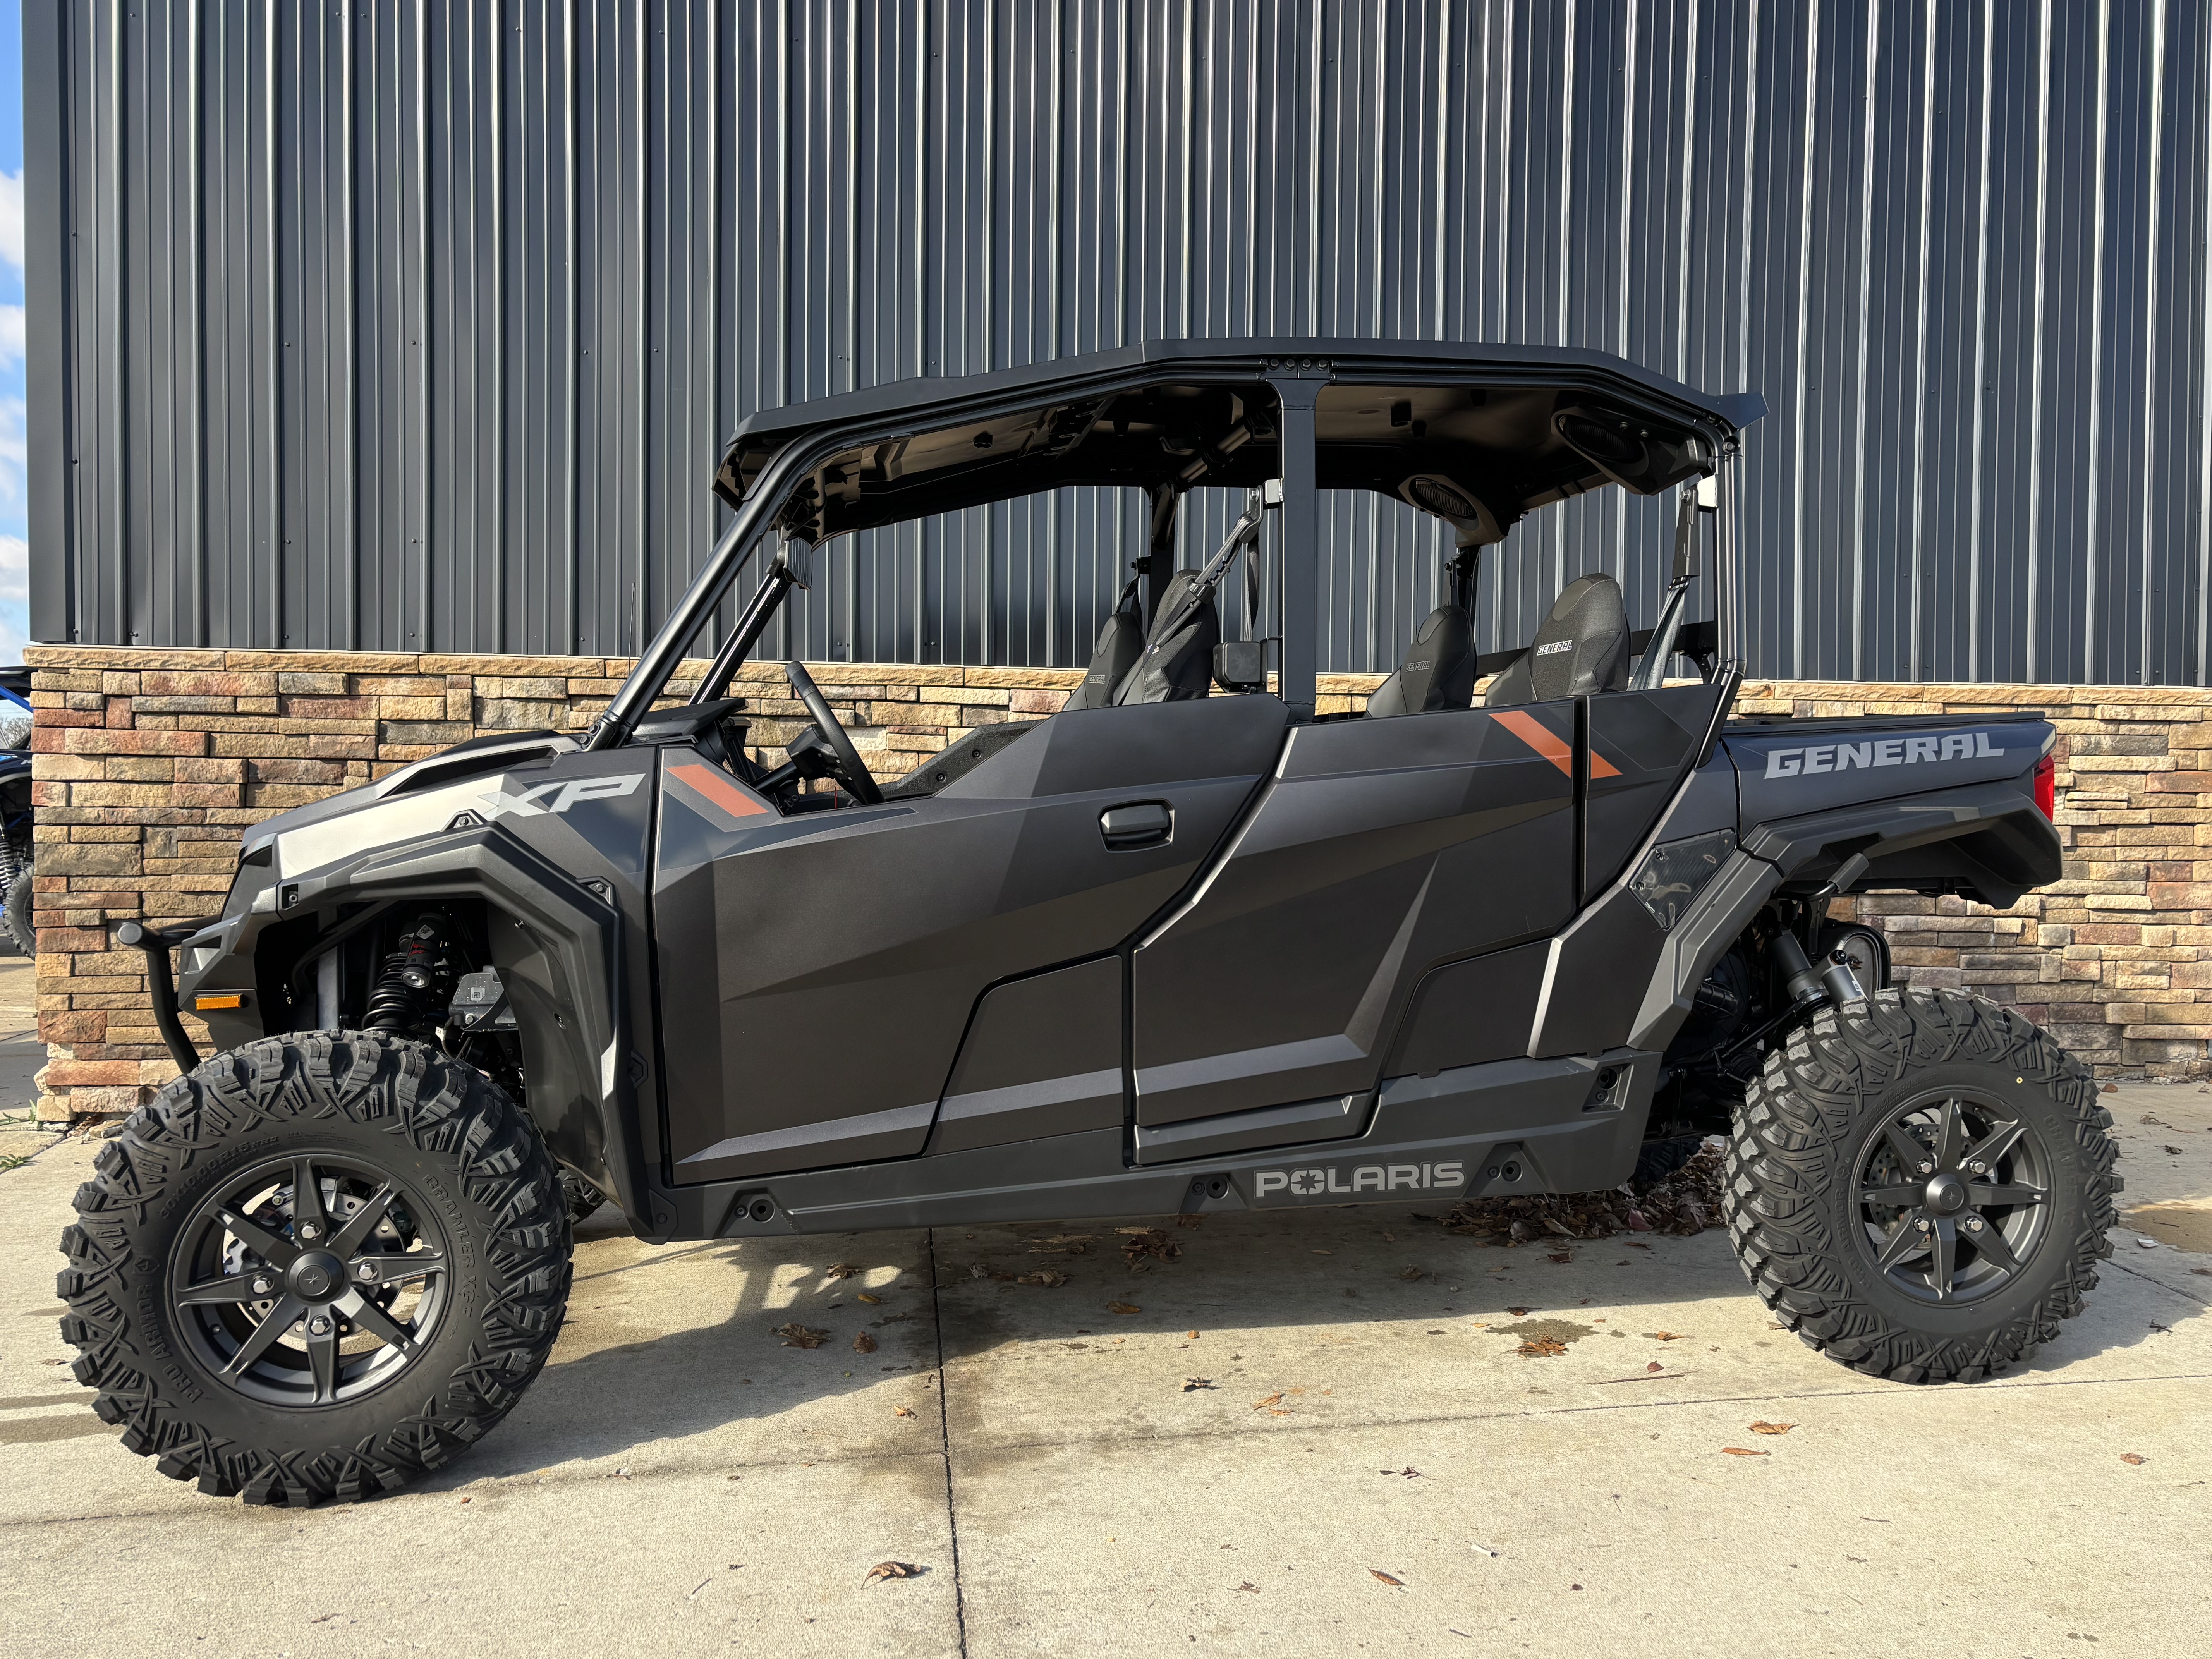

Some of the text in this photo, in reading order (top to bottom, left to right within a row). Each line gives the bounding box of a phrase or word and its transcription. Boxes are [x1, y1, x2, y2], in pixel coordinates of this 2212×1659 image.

[1405, 660, 1430, 672] GENERAL
[1536, 639, 1572, 656] GENERAL
[1764, 733, 2004, 779] GENERAL
[478, 773, 646, 820] XP
[1255, 1161, 1465, 1197] POLARIS
[422, 1174, 476, 1268] CRAWLER
[1835, 1188, 1853, 1252] ARMOR
[136, 1284, 204, 1403] PRO ARMOR
